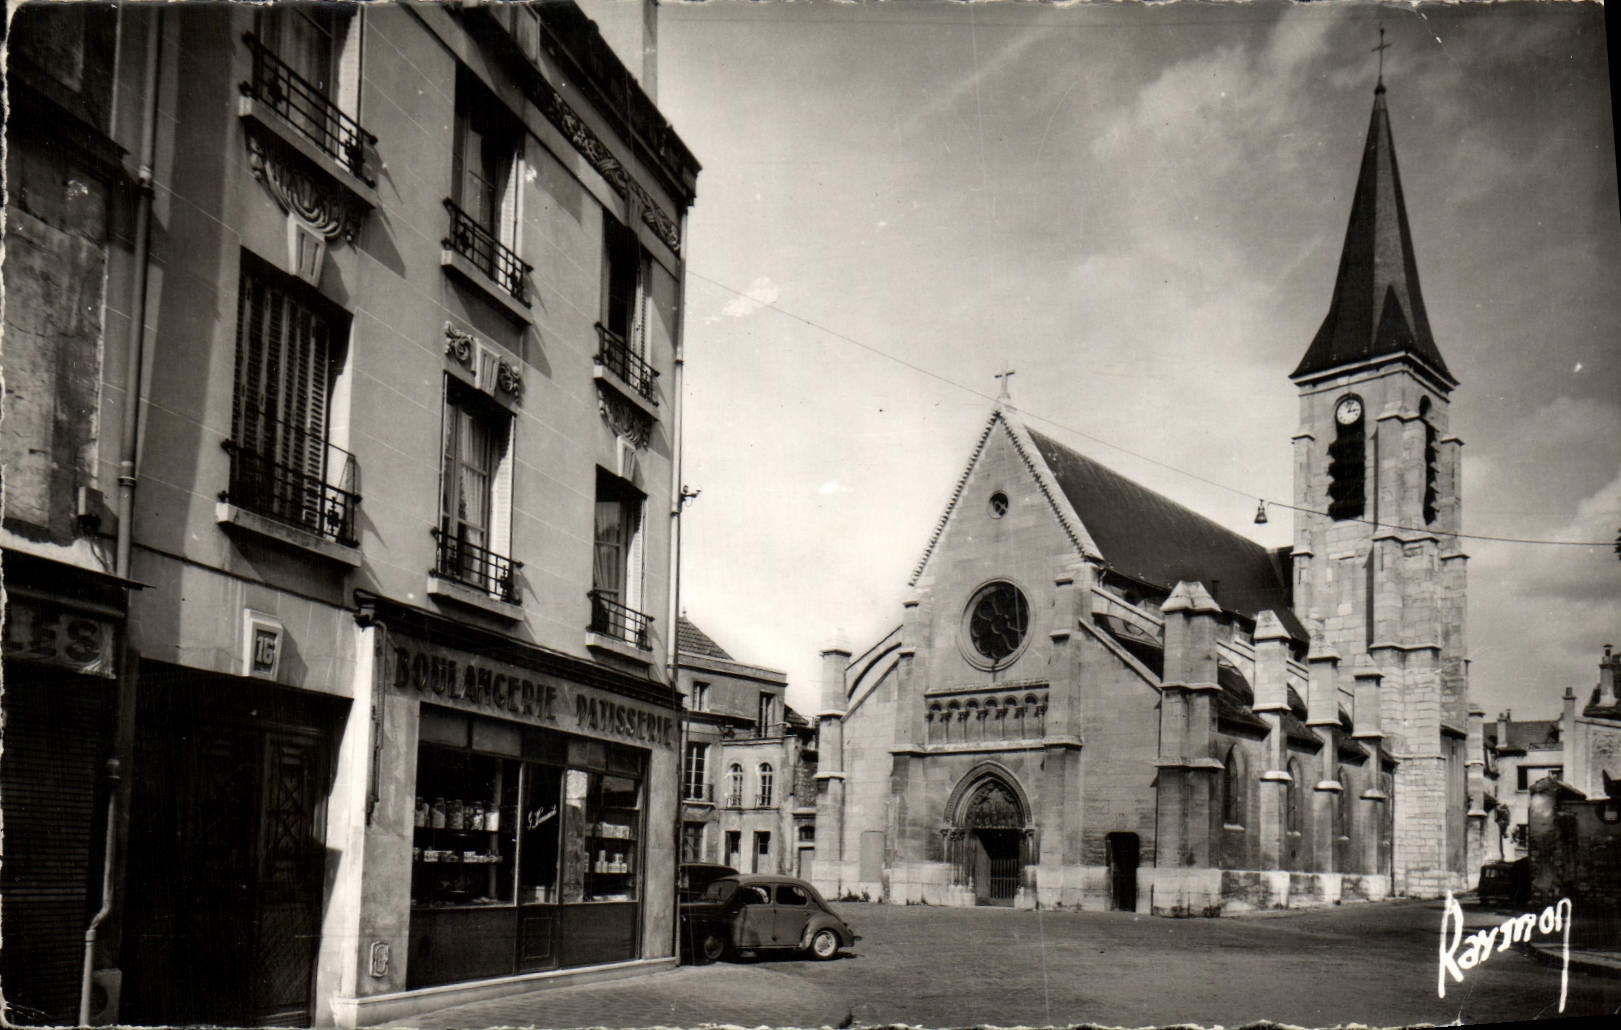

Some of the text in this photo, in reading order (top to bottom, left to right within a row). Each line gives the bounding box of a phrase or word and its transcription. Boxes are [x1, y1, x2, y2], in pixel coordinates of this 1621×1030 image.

[256, 636, 274, 664] 16
[394, 647, 672, 745] BOULANGERIE PATISSERIE
